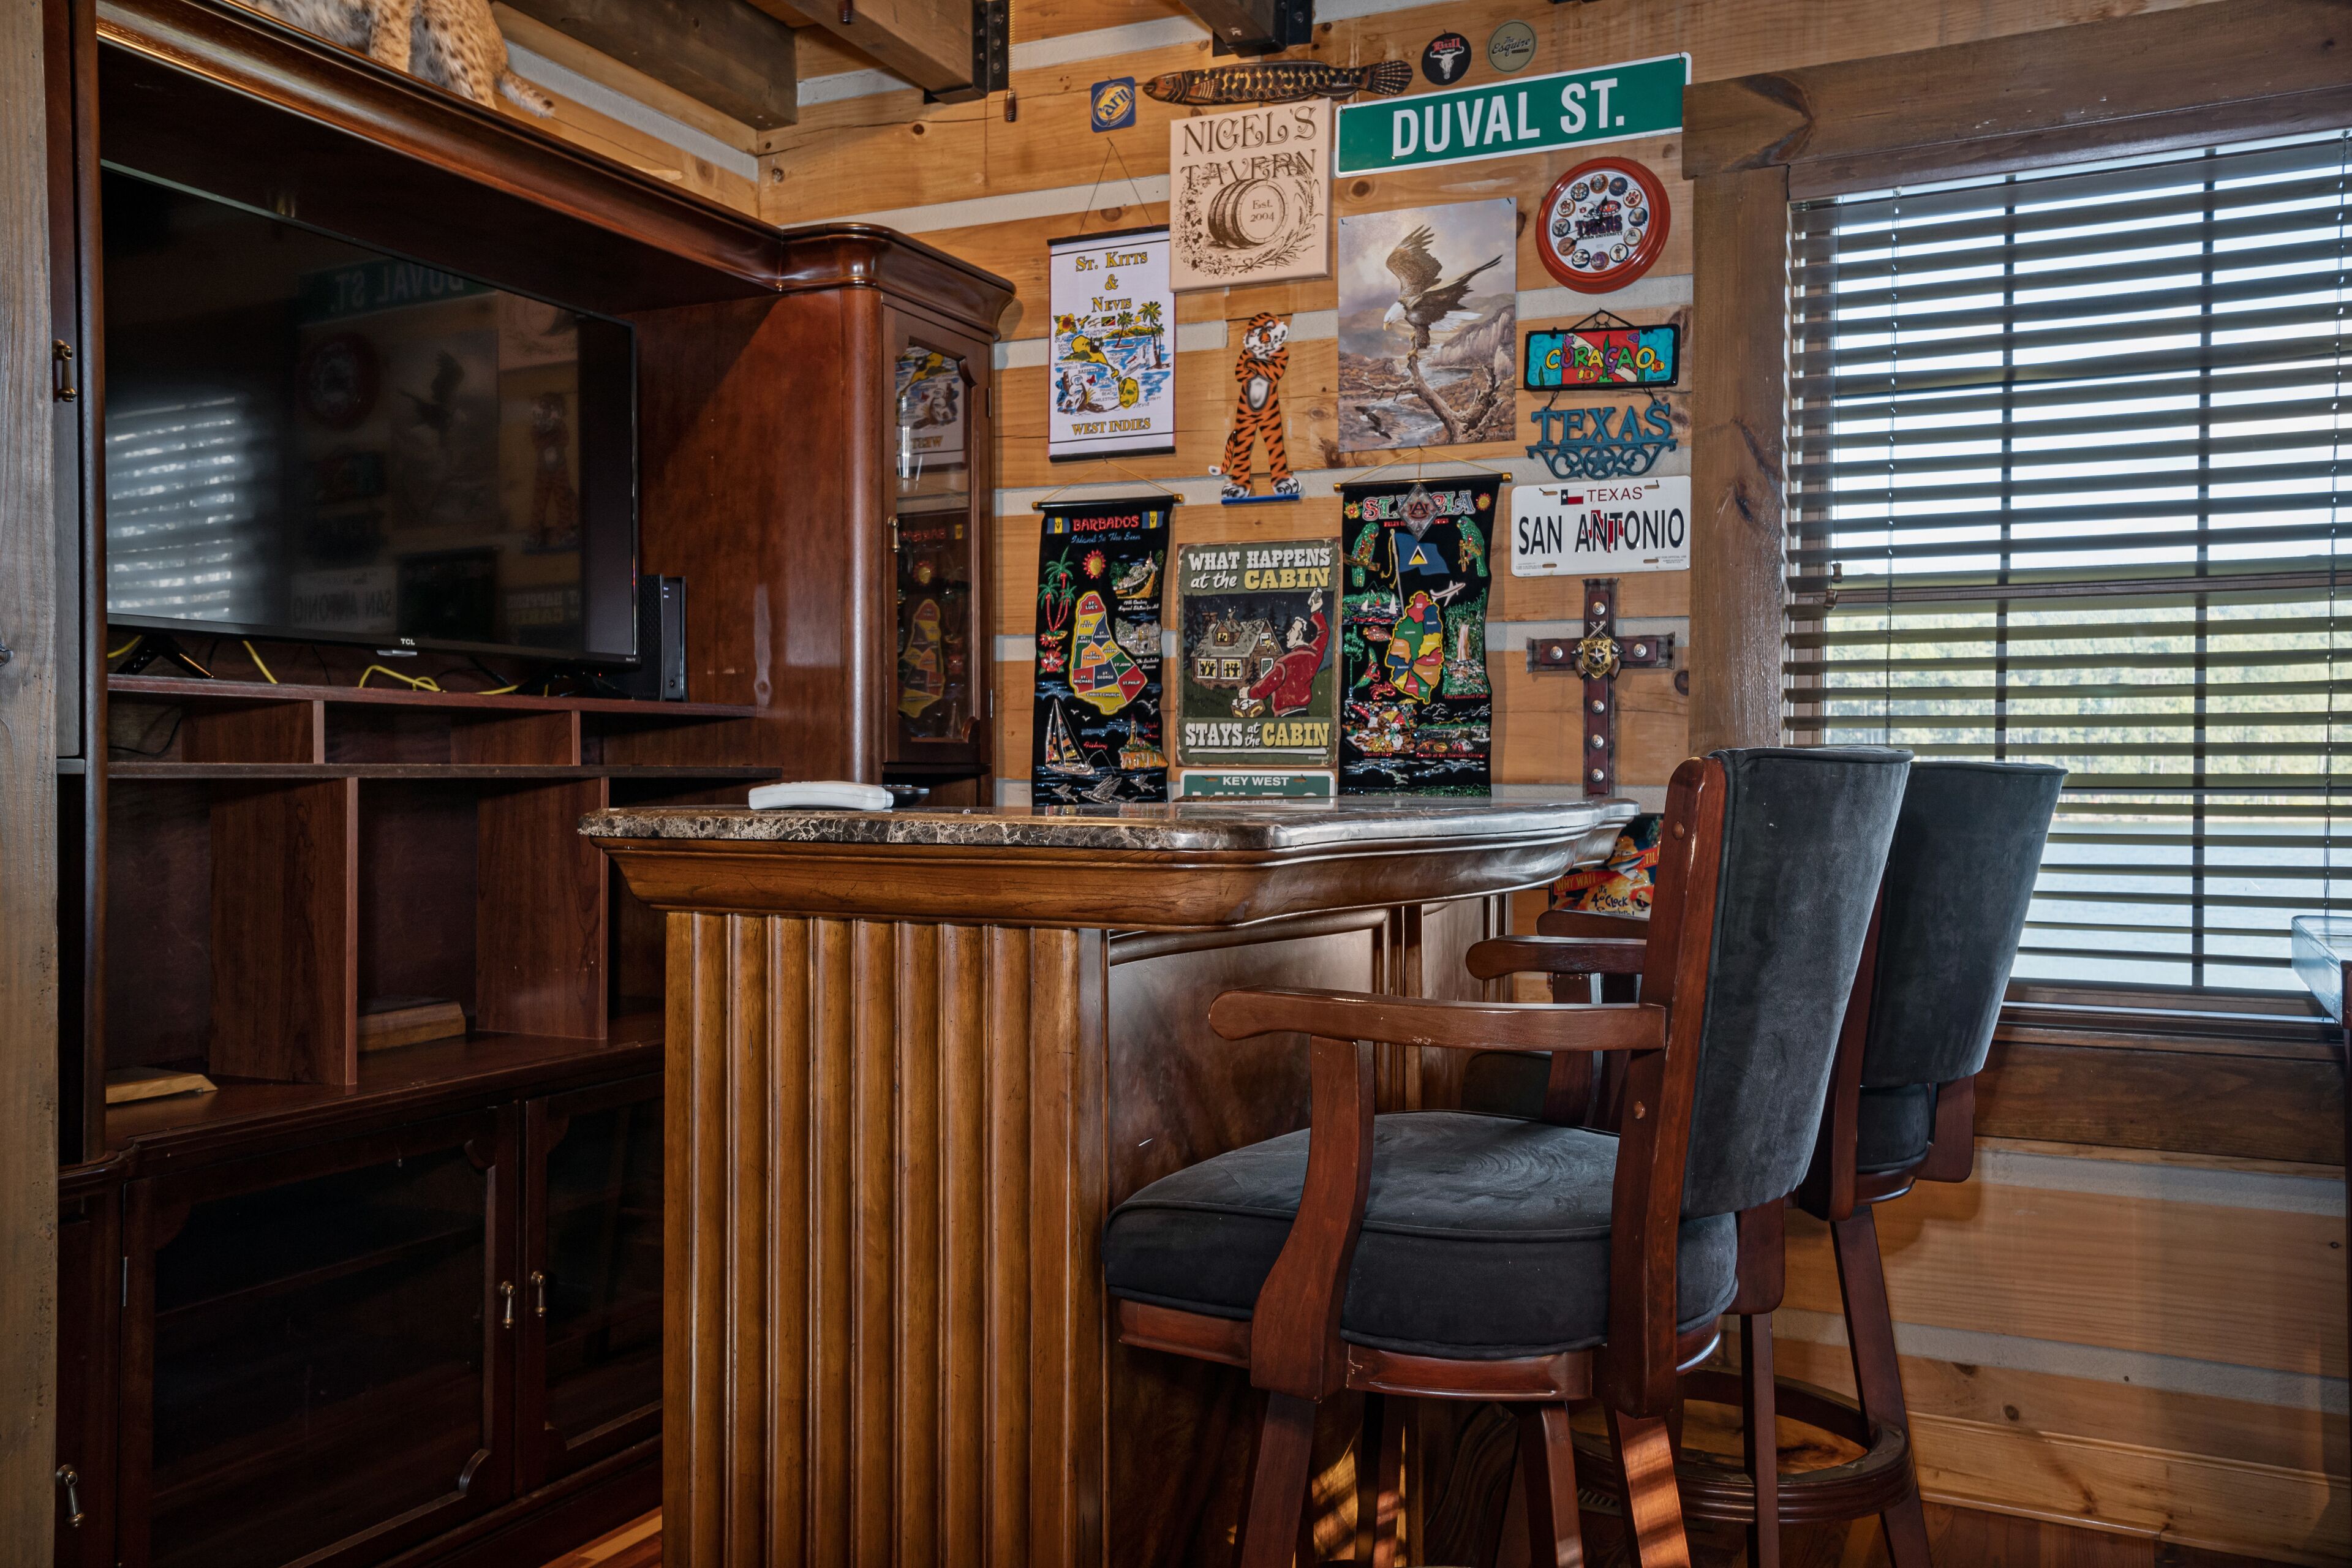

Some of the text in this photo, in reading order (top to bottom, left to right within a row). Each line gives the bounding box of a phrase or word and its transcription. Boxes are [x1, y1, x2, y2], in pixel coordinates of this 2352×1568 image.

[1492, 39, 1531, 57] Esquire
[1392, 78, 1624, 157] DUVAL ST.
[1183, 106, 1317, 157] NIGEL'S
[1180, 149, 1317, 190] TAVERN
[1252, 200, 1273, 210] Est.
[1250, 213, 1275, 222] 2004
[1104, 274, 1119, 290] &
[1545, 346, 1656, 373] CURAÇAO
[1071, 418, 1151, 436] WEST INDIES
[1531, 403, 1673, 445] TEXAS
[1586, 487, 1643, 502] TEXAS
[1072, 515, 1139, 532] BARBADOS
[1518, 508, 1684, 555] SAN ANTONIO
[1071, 534, 1097, 544] Island
[1109, 532, 1121, 541] The
[1124, 532, 1140, 541] Sun
[1188, 548, 1331, 571] WHAT HAPPENS
[1191, 568, 1331, 590] at the CABIN
[1185, 721, 1330, 748] STAYS at the CABIN
[1223, 777, 1289, 786] KEY WEST
[1556, 877, 1573, 892] WHY
